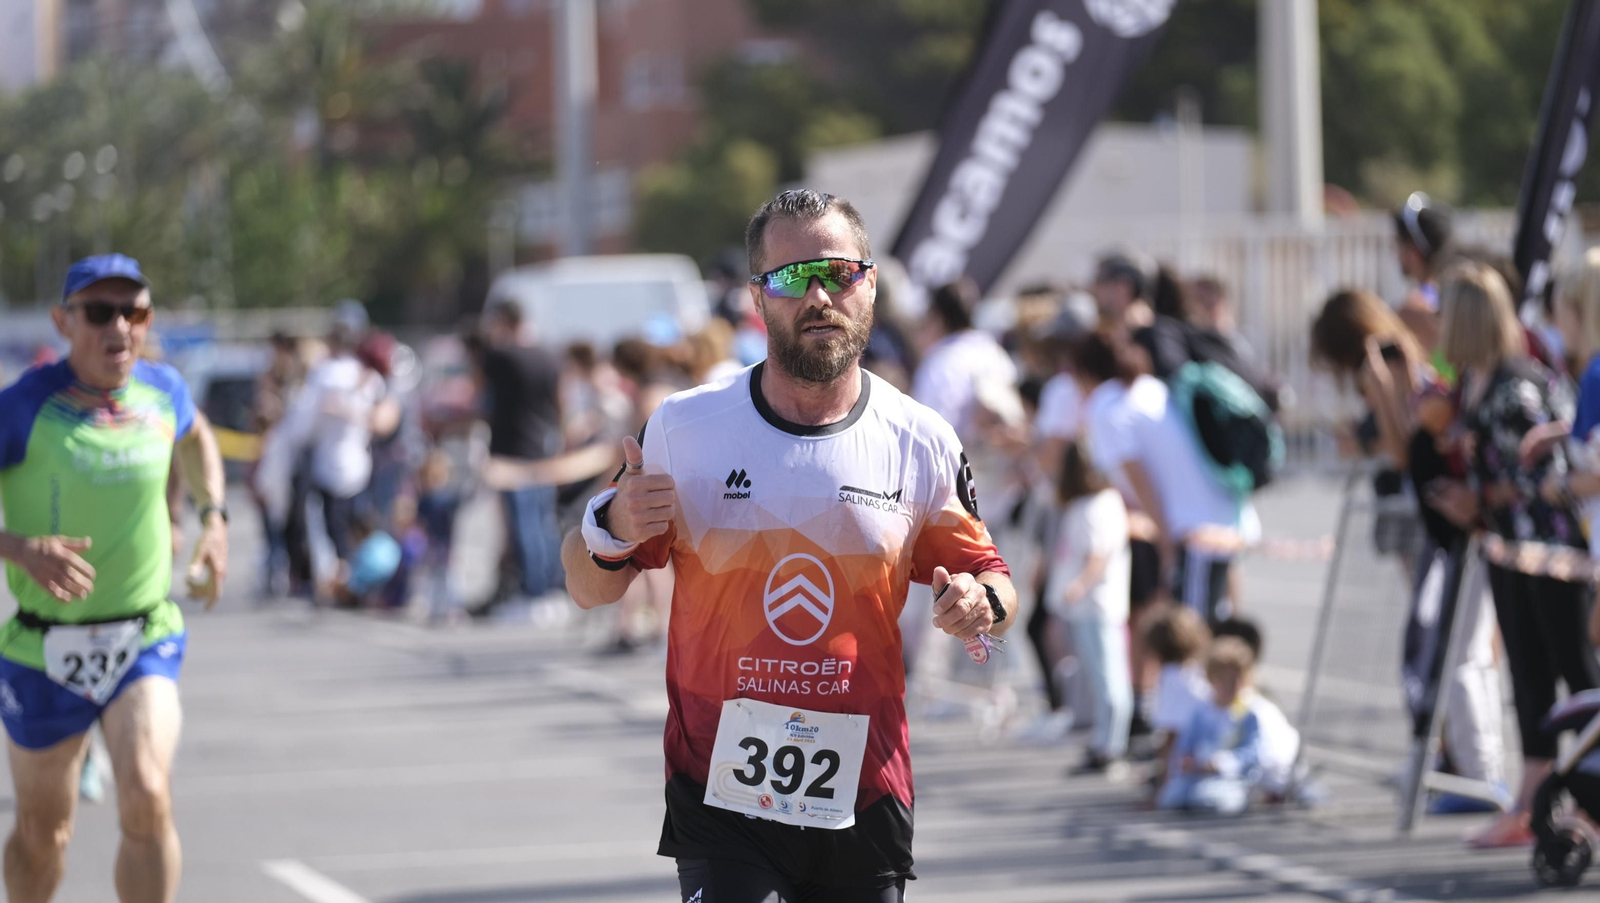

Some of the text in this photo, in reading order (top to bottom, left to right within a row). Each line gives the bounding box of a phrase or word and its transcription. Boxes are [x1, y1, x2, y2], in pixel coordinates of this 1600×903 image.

[723, 490, 751, 500] mobel
[838, 492, 881, 510] SALINAS
[882, 502, 899, 514] CAR
[737, 676, 850, 695] SALINAS CAR
[784, 722, 819, 733] 10km20
[733, 736, 840, 800] 392
